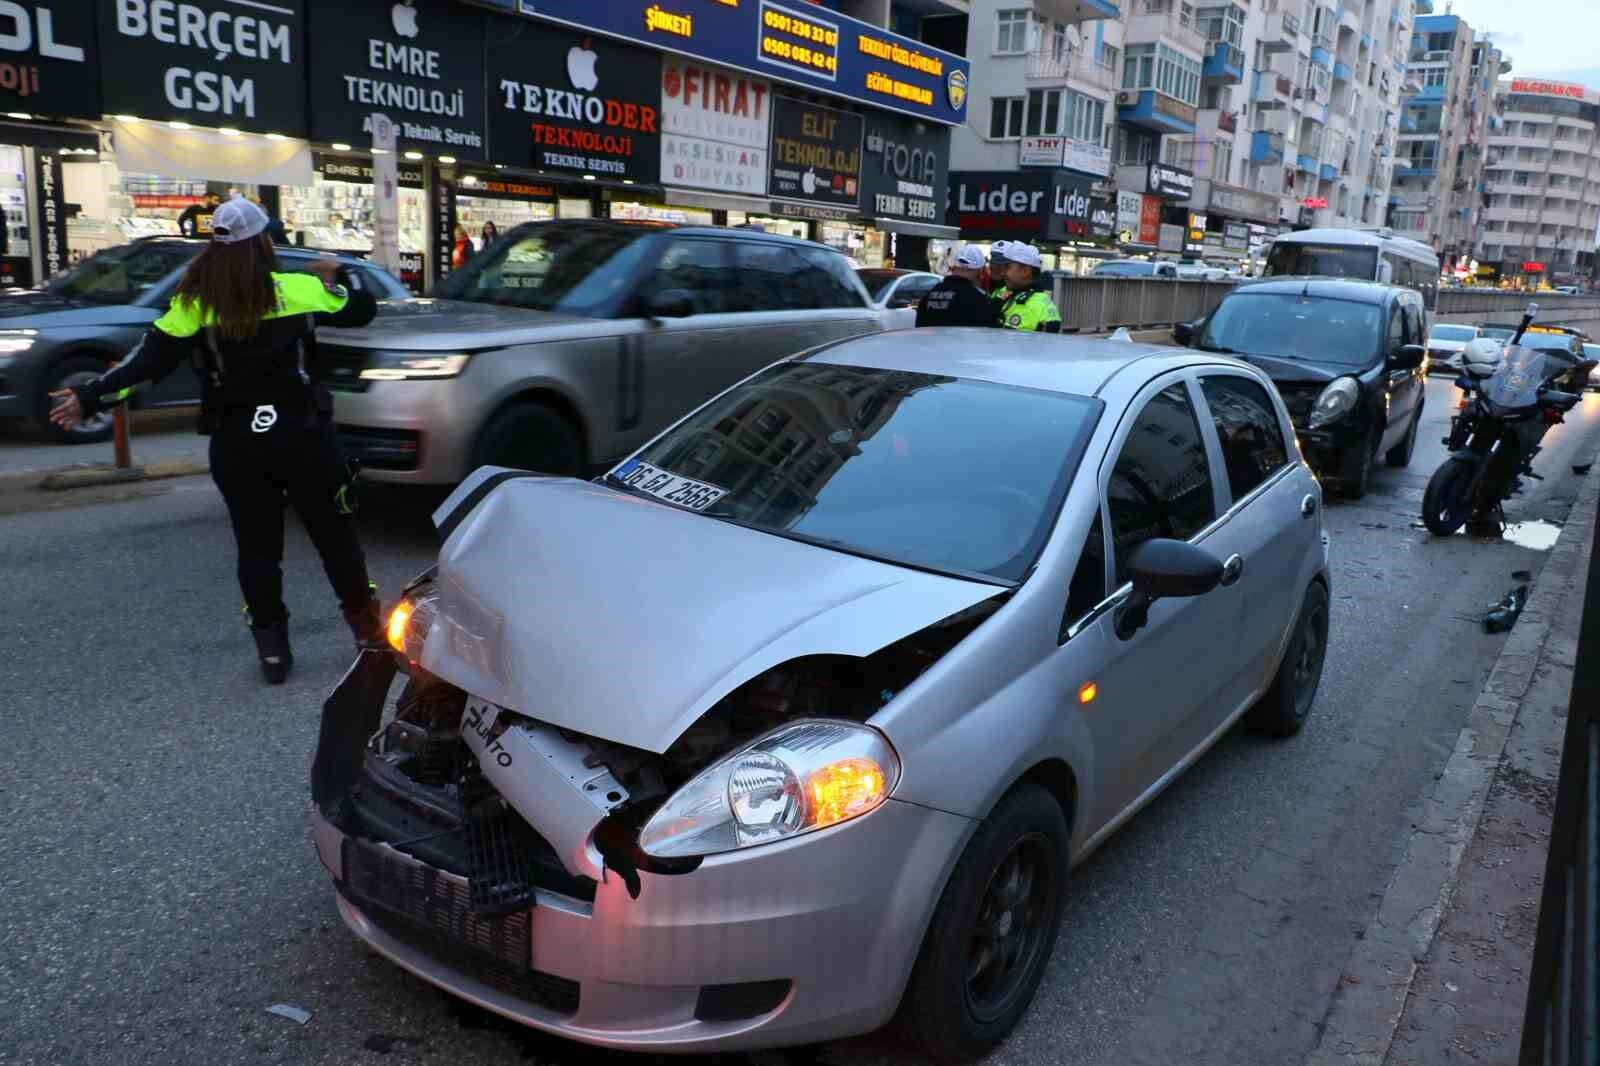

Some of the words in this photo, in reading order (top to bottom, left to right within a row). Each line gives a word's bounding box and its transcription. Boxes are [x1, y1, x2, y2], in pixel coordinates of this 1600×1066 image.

[117, 0, 290, 63] BERÇEM
[646, 5, 692, 37] ŞİRKETİ
[764, 11, 791, 32] 0501
[369, 38, 440, 79] EMRE
[763, 36, 791, 58] 0505
[164, 67, 255, 117] GSM
[344, 75, 464, 117] TEKNOLOJİ
[501, 79, 656, 132] TEKNODER
[684, 65, 767, 120] FIRAT
[403, 122, 442, 142] Teknik
[445, 128, 481, 147] Servis
[532, 124, 632, 156] TEKNOLOJİ
[326, 163, 360, 176] EMRE
[544, 152, 585, 169] TEKNİK
[959, 184, 1043, 213] Lider
[1054, 185, 1090, 218] Lider
[624, 464, 653, 487] 06
[664, 482, 720, 509] 2566
